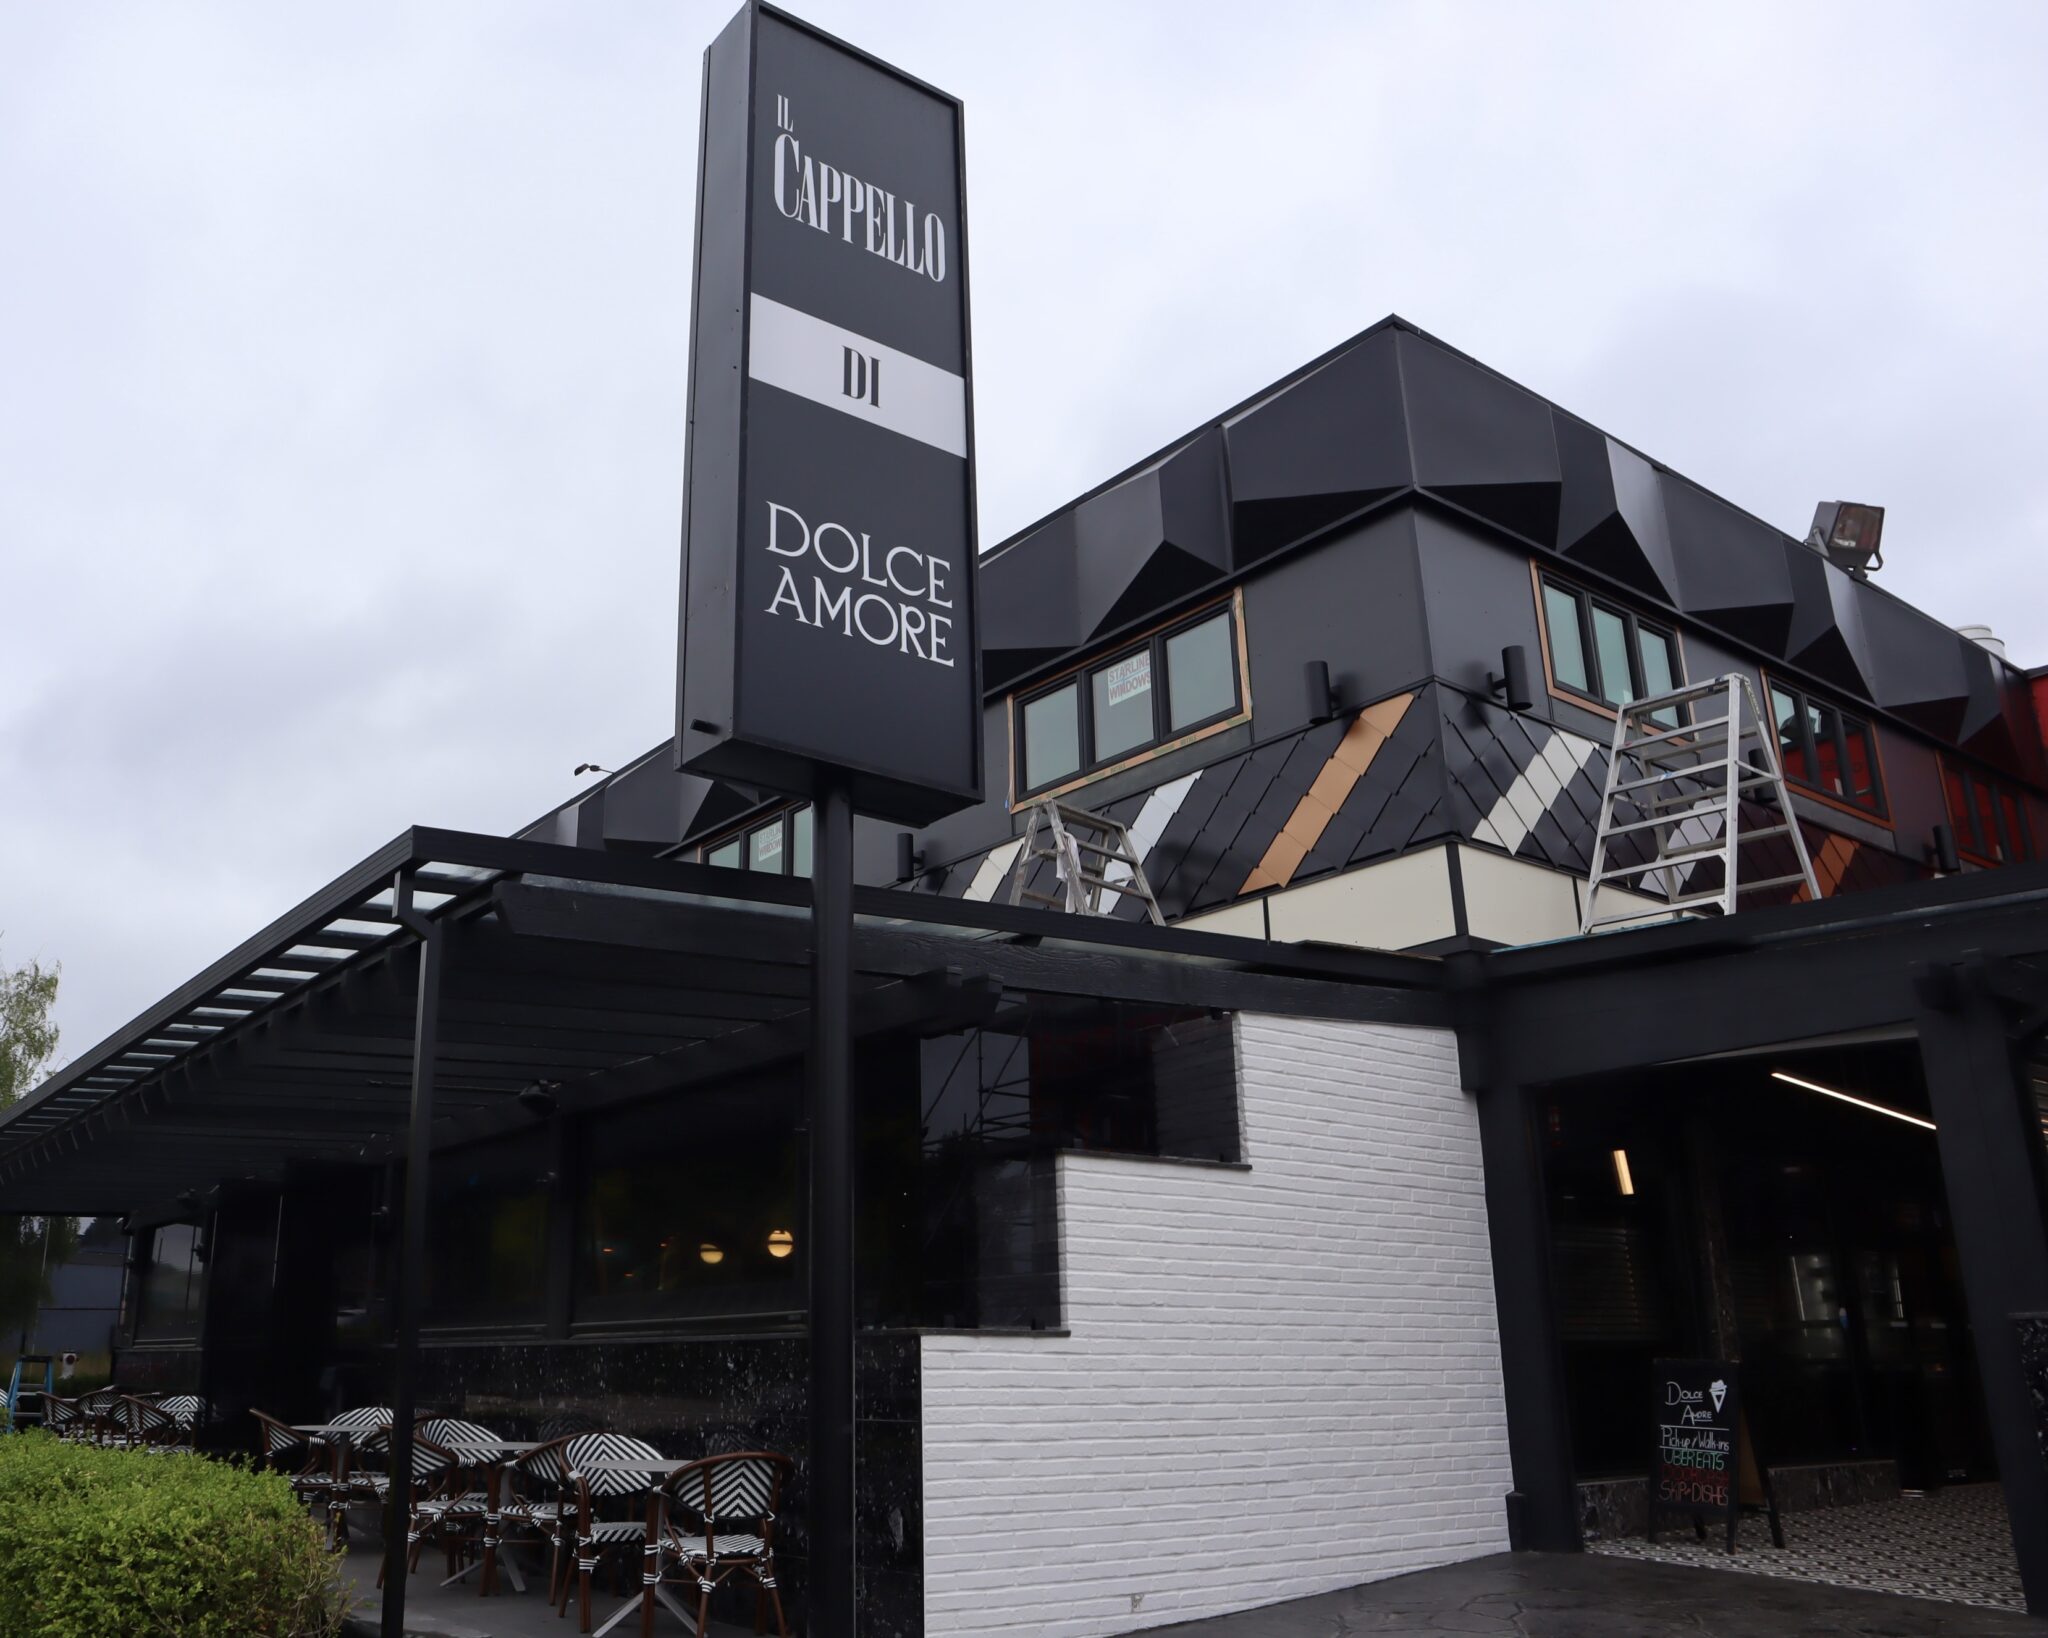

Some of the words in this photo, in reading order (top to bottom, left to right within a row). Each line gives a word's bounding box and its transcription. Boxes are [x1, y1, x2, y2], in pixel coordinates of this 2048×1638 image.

[777, 94, 793, 132] IL
[774, 133, 946, 282] CAPPELLO
[842, 345, 880, 408] DI
[765, 501, 952, 609] DOLCE
[764, 565, 954, 667] AMORE
